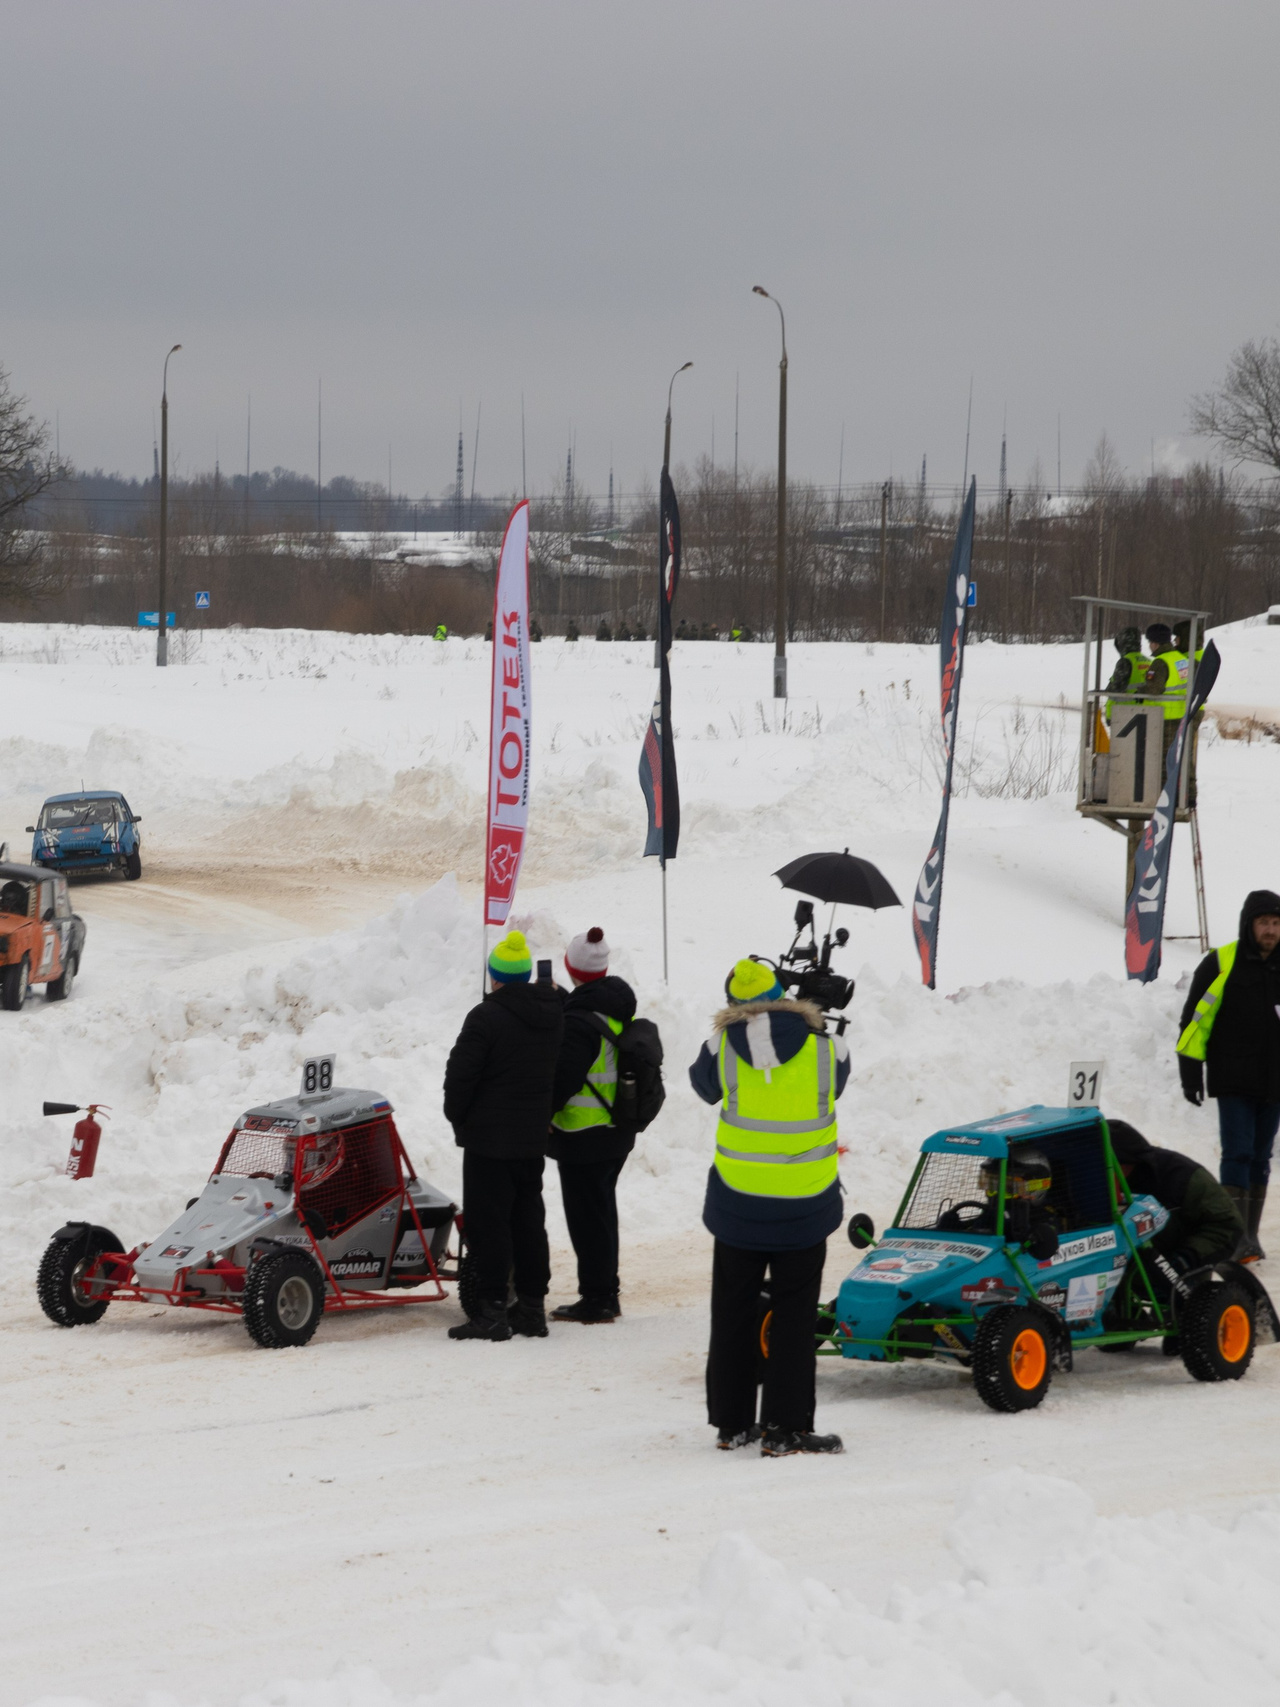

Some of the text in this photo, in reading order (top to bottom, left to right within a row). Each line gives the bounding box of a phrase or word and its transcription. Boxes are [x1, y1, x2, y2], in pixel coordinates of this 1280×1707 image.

[1117, 713, 1148, 803] 1
[304, 1058, 333, 1095] 88
[1073, 1070, 1099, 1101] 31
[937, 1243, 987, 1259] РОССИИ
[1086, 1232, 1116, 1251] Иван
[330, 1261, 381, 1275] KRAMAR
